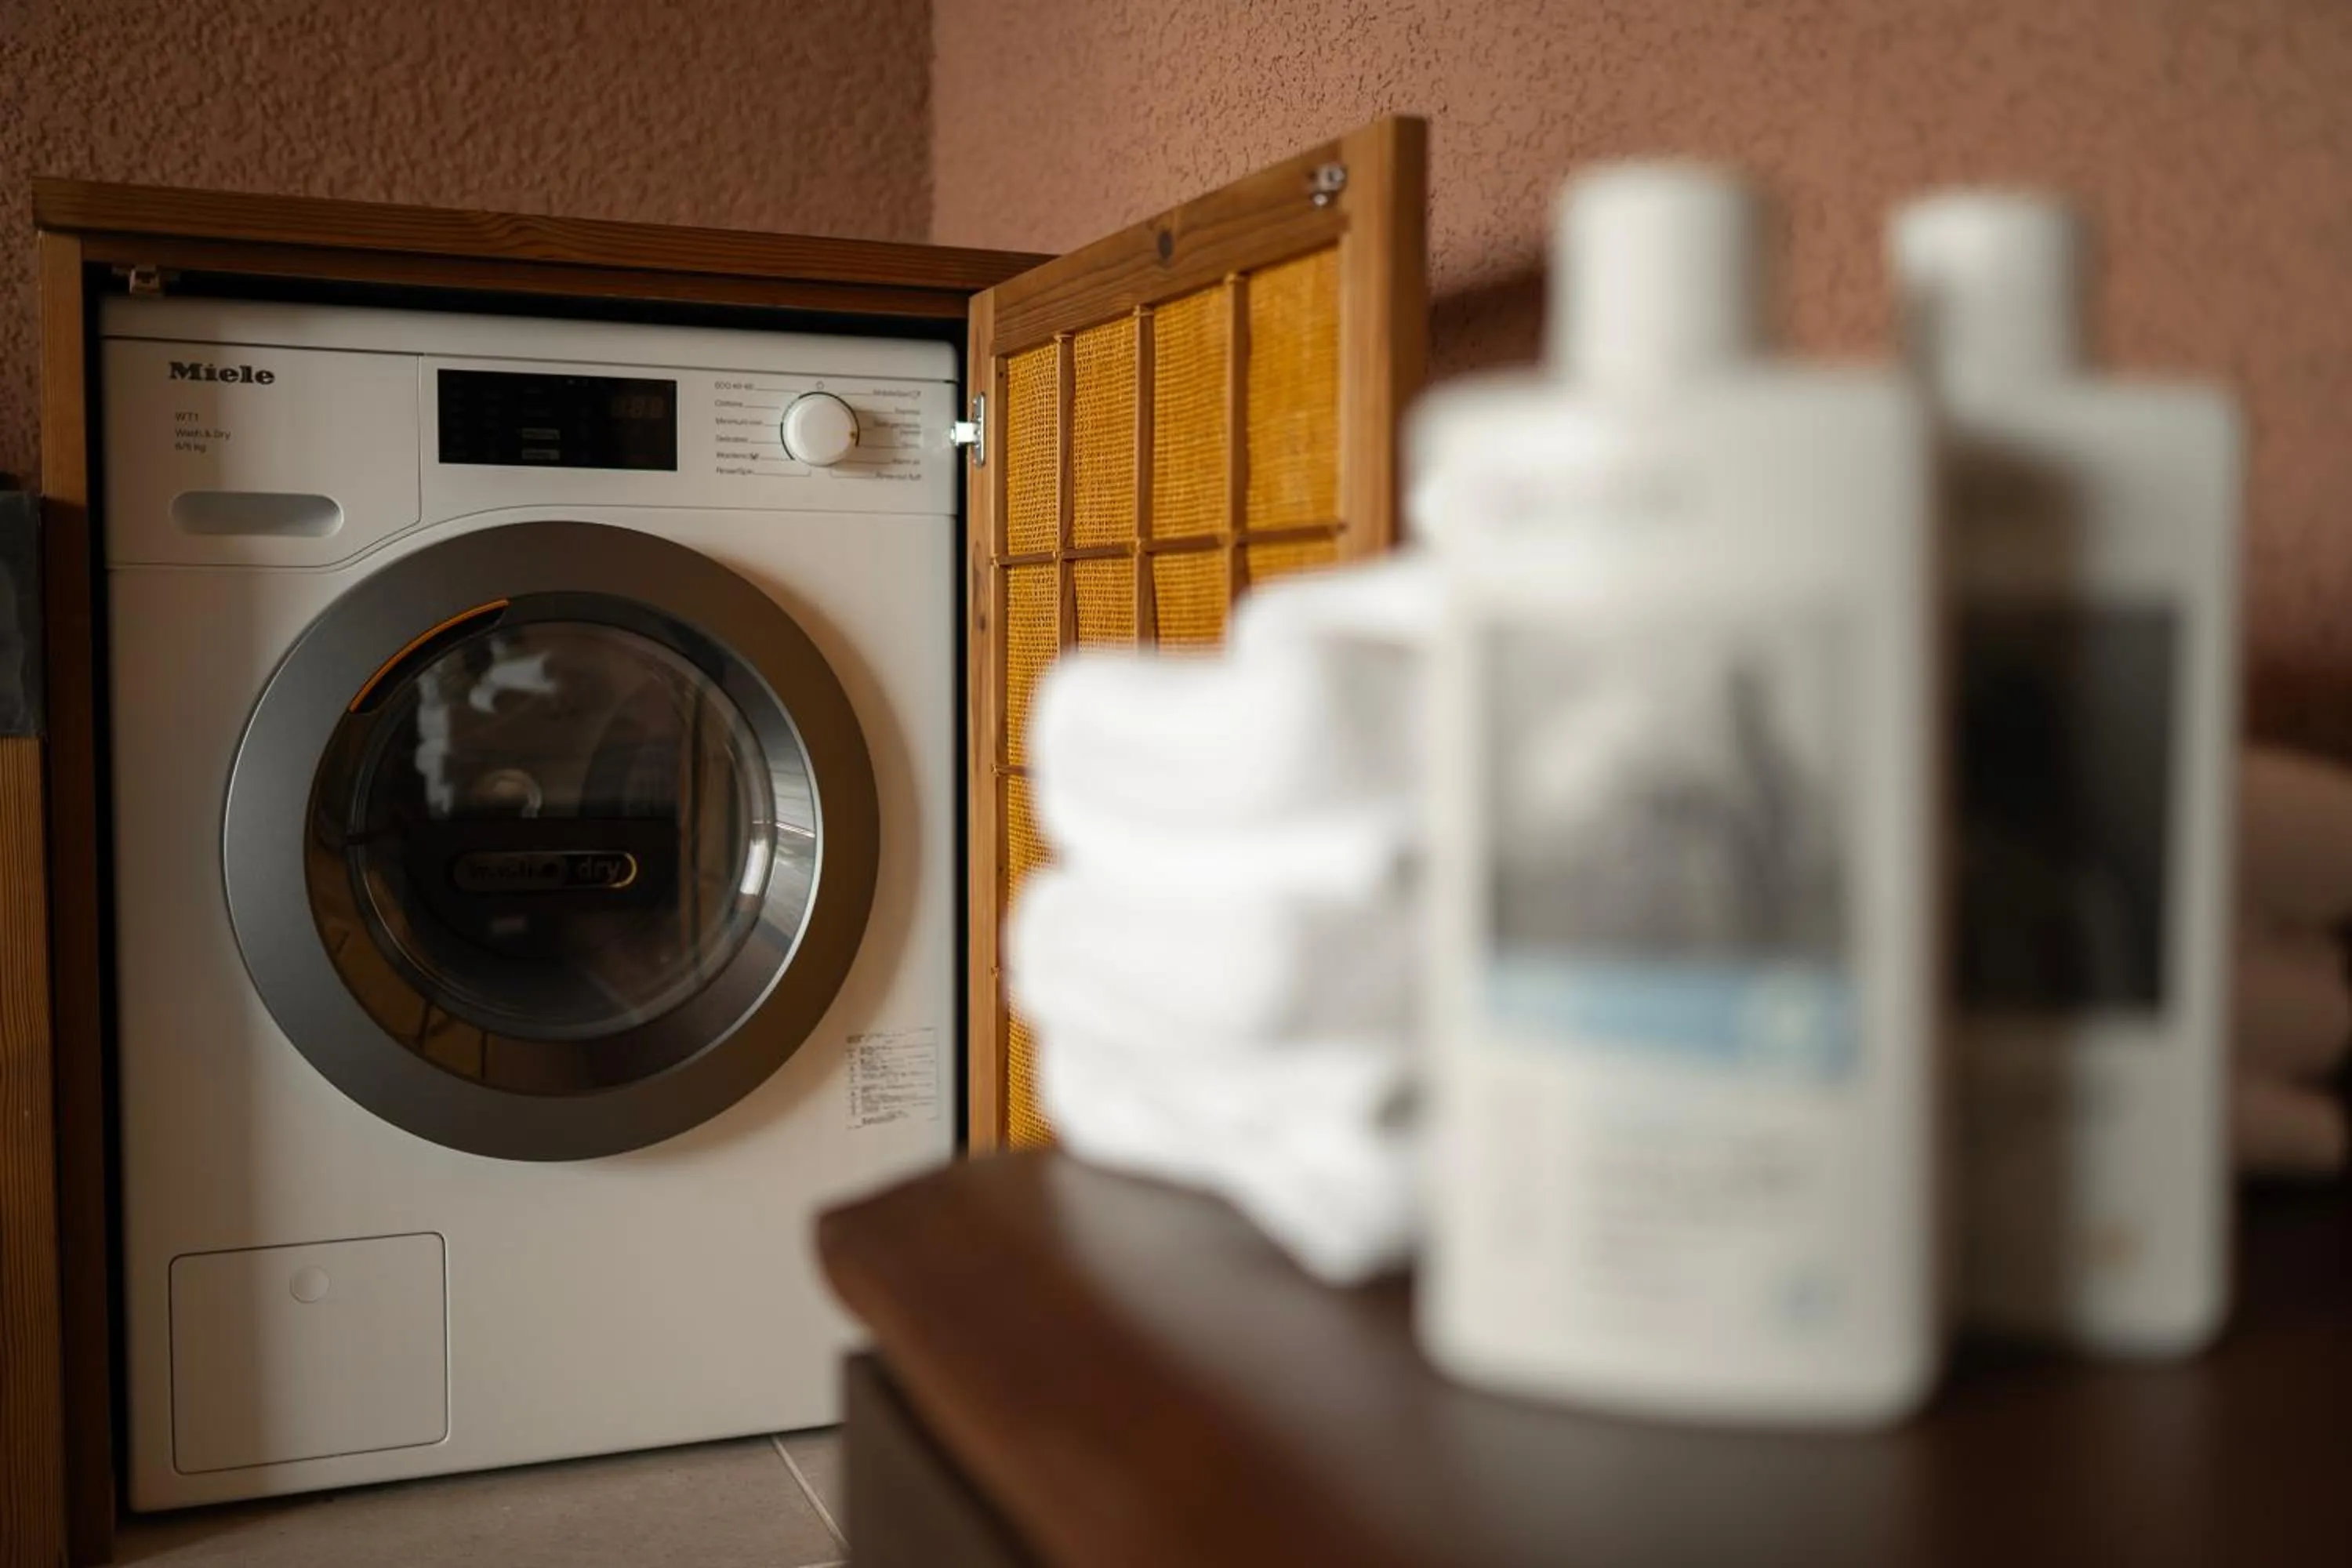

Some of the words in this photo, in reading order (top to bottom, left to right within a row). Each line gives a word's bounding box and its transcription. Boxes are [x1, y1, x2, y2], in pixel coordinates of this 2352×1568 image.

[169, 361, 275, 385] Miele
[174, 412, 198, 422] WT1
[213, 429, 231, 441] Dry
[576, 855, 621, 883] dry
